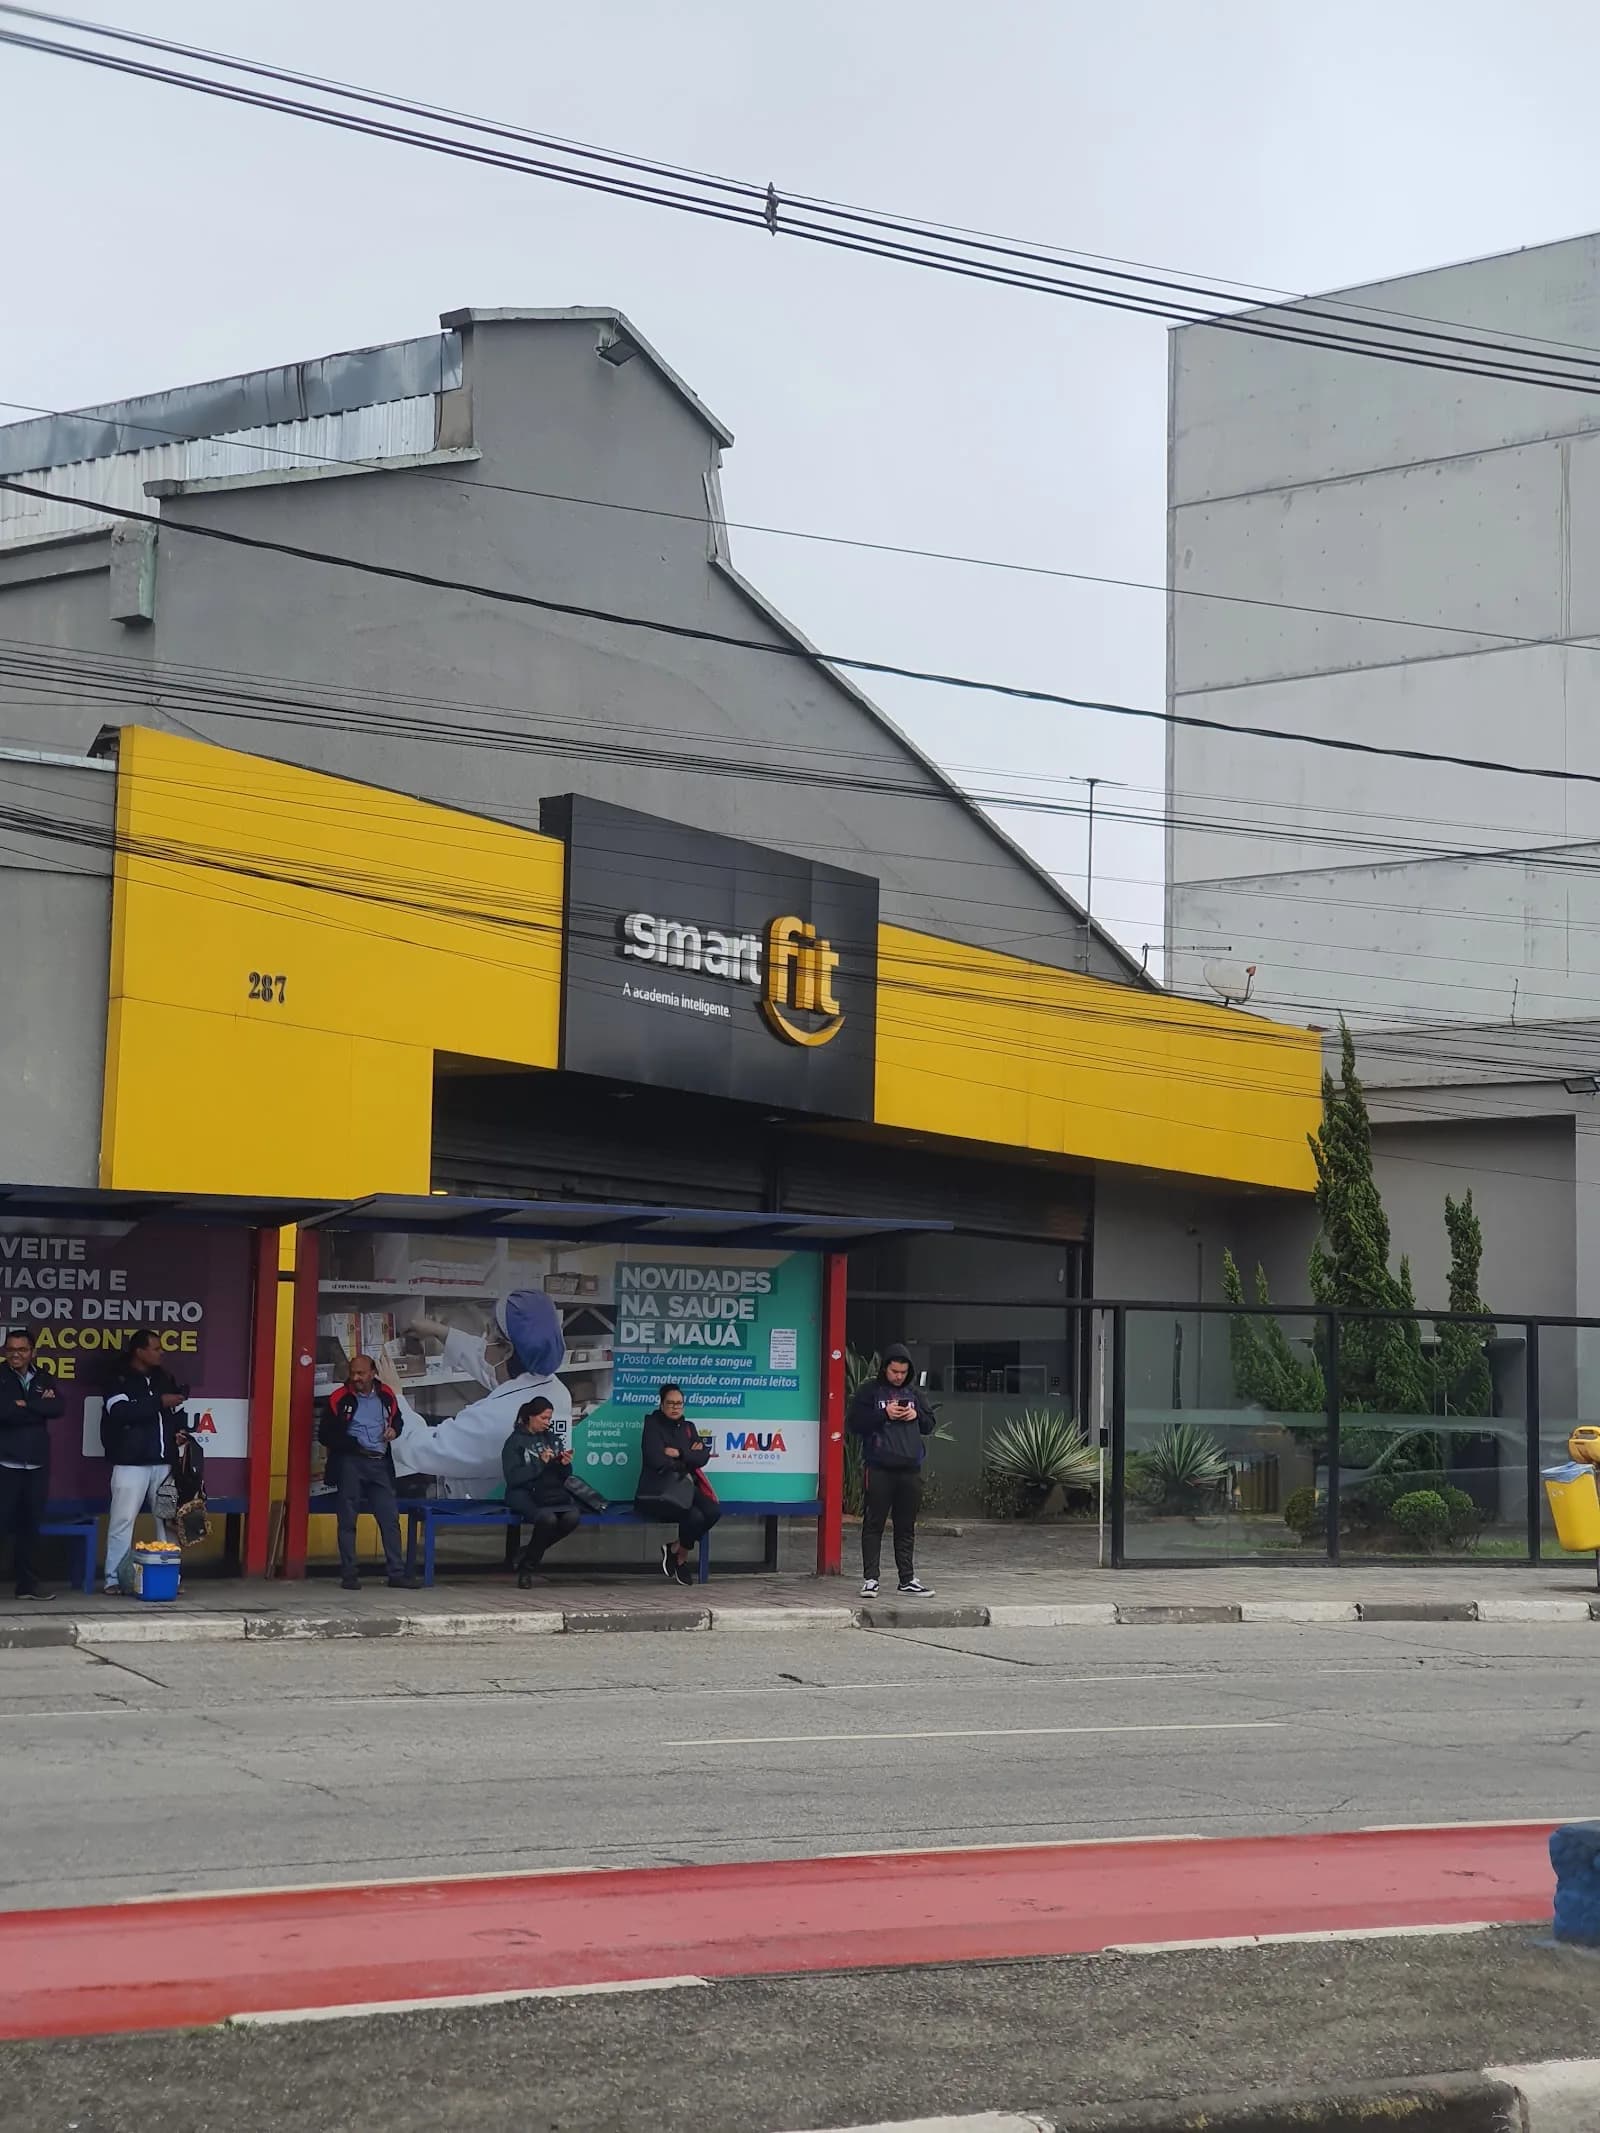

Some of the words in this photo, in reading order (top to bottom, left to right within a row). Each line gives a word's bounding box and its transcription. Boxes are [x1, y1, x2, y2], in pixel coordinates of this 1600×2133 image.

[624, 913, 762, 985] smart
[769, 916, 840, 1015] fit
[248, 971, 287, 1004] 287
[622, 981, 632, 996] A
[633, 987, 680, 1007] academia
[681, 994, 732, 1018] inteligente.
[0, 1267, 101, 1291] IAGEM
[109, 1270, 127, 1291] E
[621, 1266, 772, 1293] NOVIDADES
[10, 1297, 73, 1320] POR
[82, 1299, 203, 1323] DENTRO
[621, 1294, 660, 1317] NA
[668, 1291, 755, 1320] SAÚDE
[620, 1322, 656, 1344] DE
[664, 1319, 742, 1346] MAUÁ
[622, 1353, 651, 1365] Posto
[652, 1354, 665, 1365] de
[666, 1355, 698, 1366] coleta
[700, 1355, 713, 1366] de
[714, 1358, 753, 1371] sangue
[622, 1373, 649, 1384] Nova
[650, 1373, 717, 1386] maternidade
[718, 1377, 741, 1387] com
[742, 1376, 768, 1387] mais
[769, 1376, 798, 1388] leitos
[688, 1391, 742, 1406] disponível
[726, 1428, 787, 1452] MAUÁ
